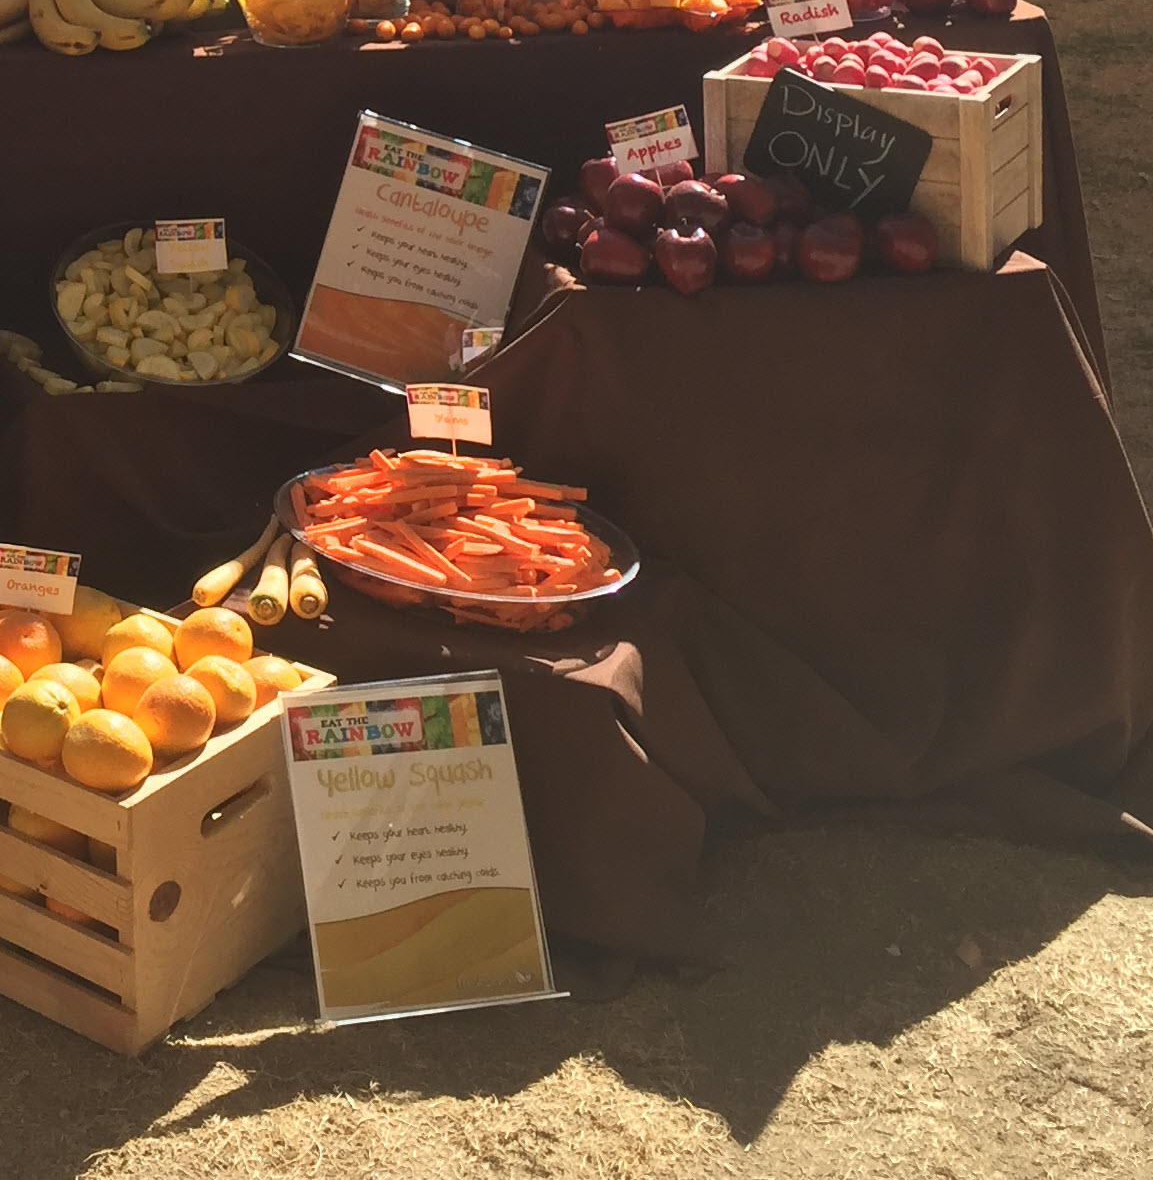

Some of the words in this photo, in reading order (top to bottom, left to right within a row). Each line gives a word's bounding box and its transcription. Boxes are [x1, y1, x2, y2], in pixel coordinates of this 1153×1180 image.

[779, 3, 839, 25] Radish
[780, 85, 896, 165] Display
[384, 144, 403, 155] EAT
[406, 151, 425, 162] THE
[626, 137, 682, 163] Apples
[368, 146, 459, 184] RAINBOW
[769, 130, 885, 209] ONLY
[376, 183, 490, 236] Cantaloupe
[7, 579, 59, 597] Oranges
[321, 719, 343, 728] EAT
[346, 716, 369, 725] THE
[306, 722, 414, 746] RAINBOW
[317, 765, 396, 797] Yellow
[409, 757, 492, 796] Squash
[350, 831, 379, 844] Keeps
[383, 829, 402, 843] your
[406, 826, 431, 836] heart
[353, 854, 382, 868] Keeps
[386, 852, 406, 866] your
[410, 850, 432, 863] eyes
[356, 878, 386, 892] Keeps
[389, 877, 406, 890] you
[410, 872, 432, 883] from
[436, 869, 472, 884] catching
